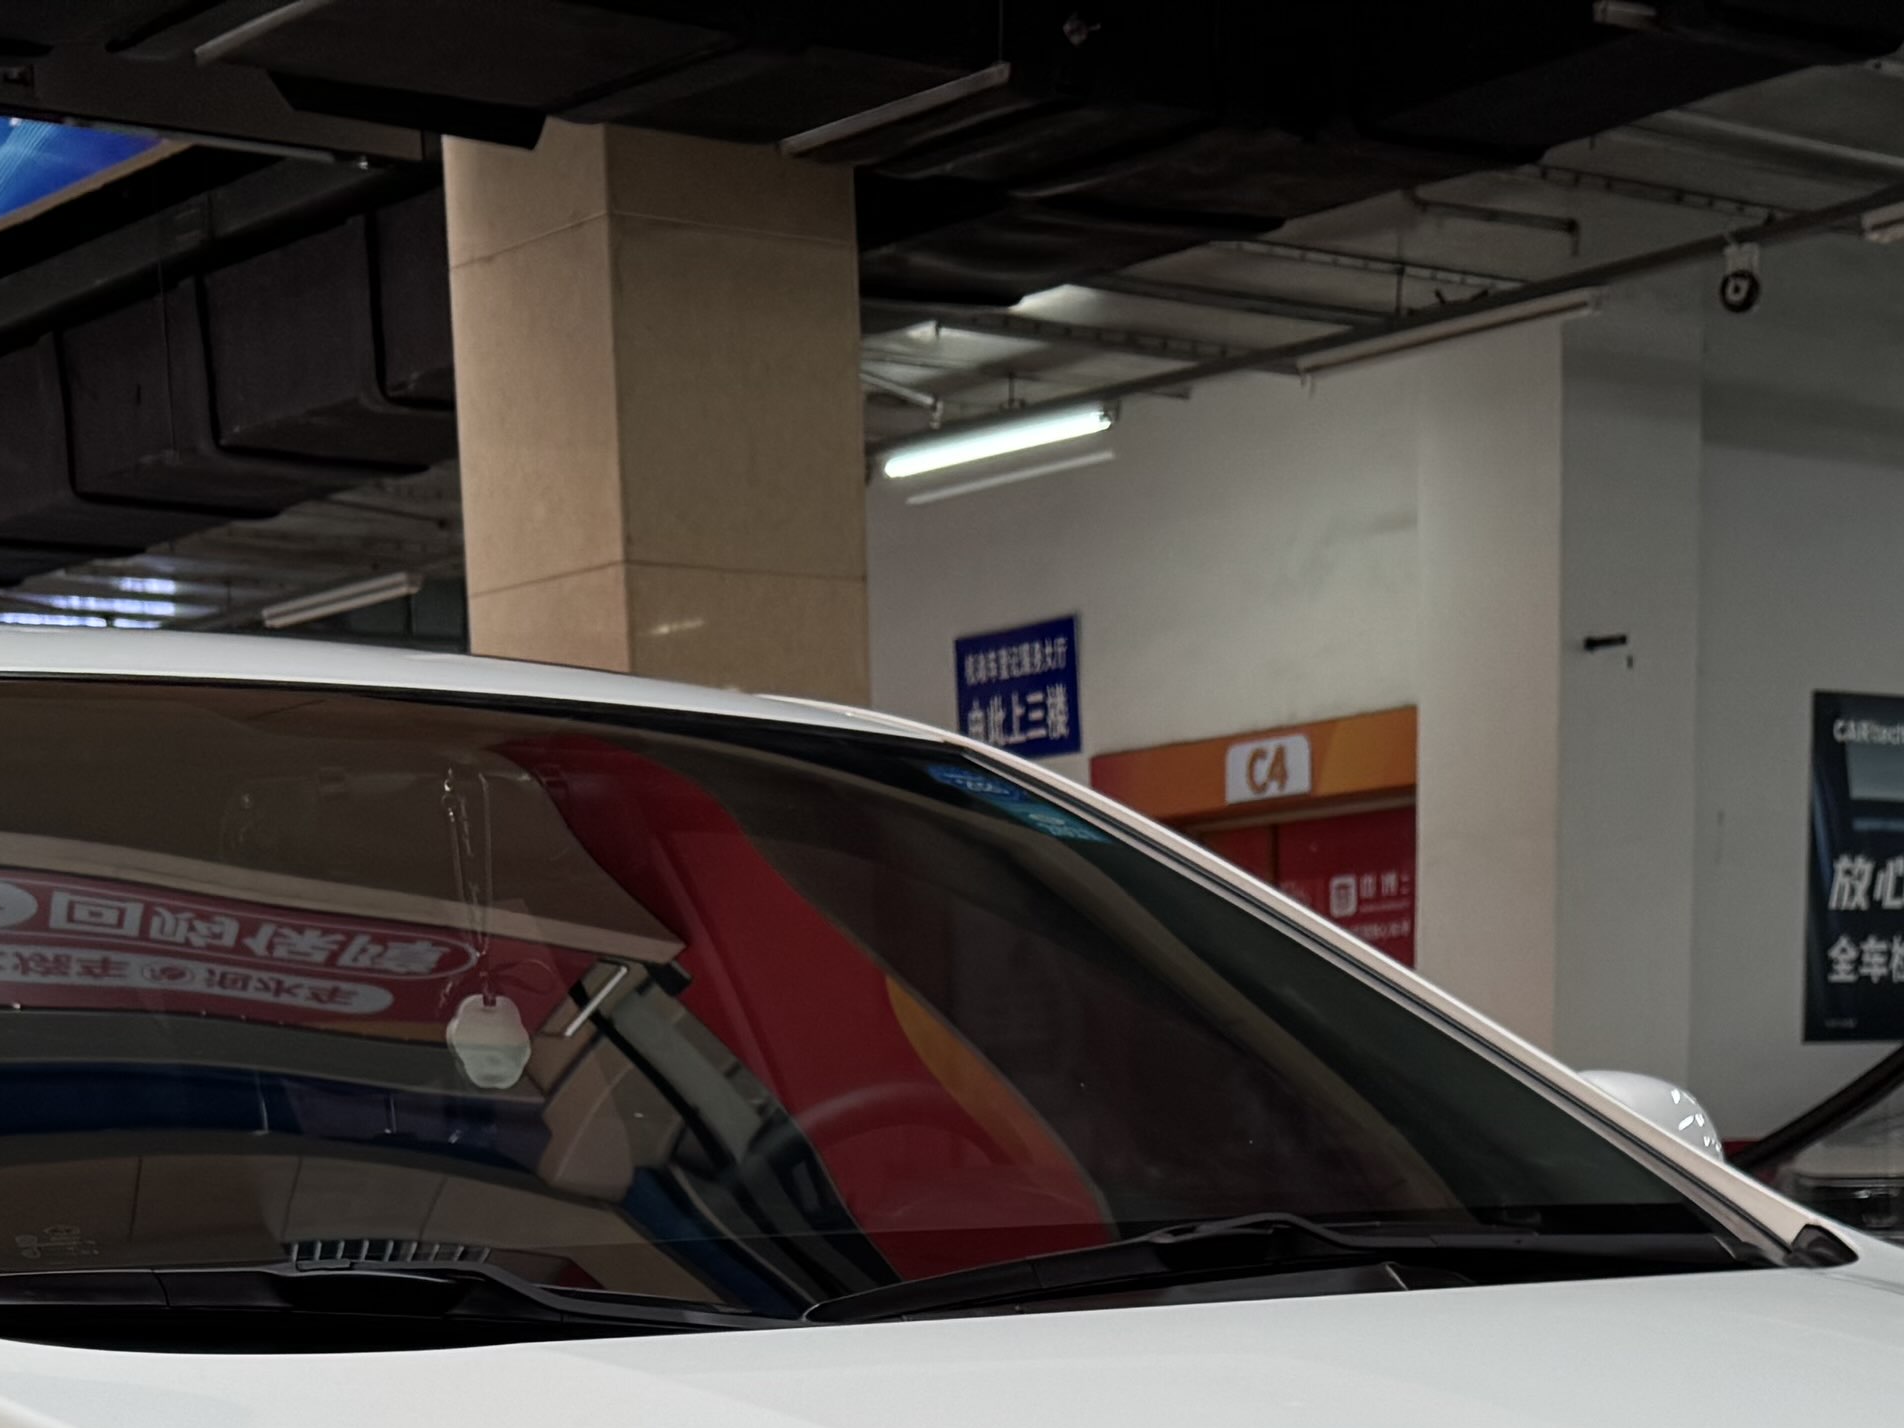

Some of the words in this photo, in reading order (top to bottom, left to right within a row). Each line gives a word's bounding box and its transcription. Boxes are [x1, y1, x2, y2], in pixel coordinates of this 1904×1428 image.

[967, 682, 1070, 746] 由此上三楼
[1247, 744, 1289, 796] C4
